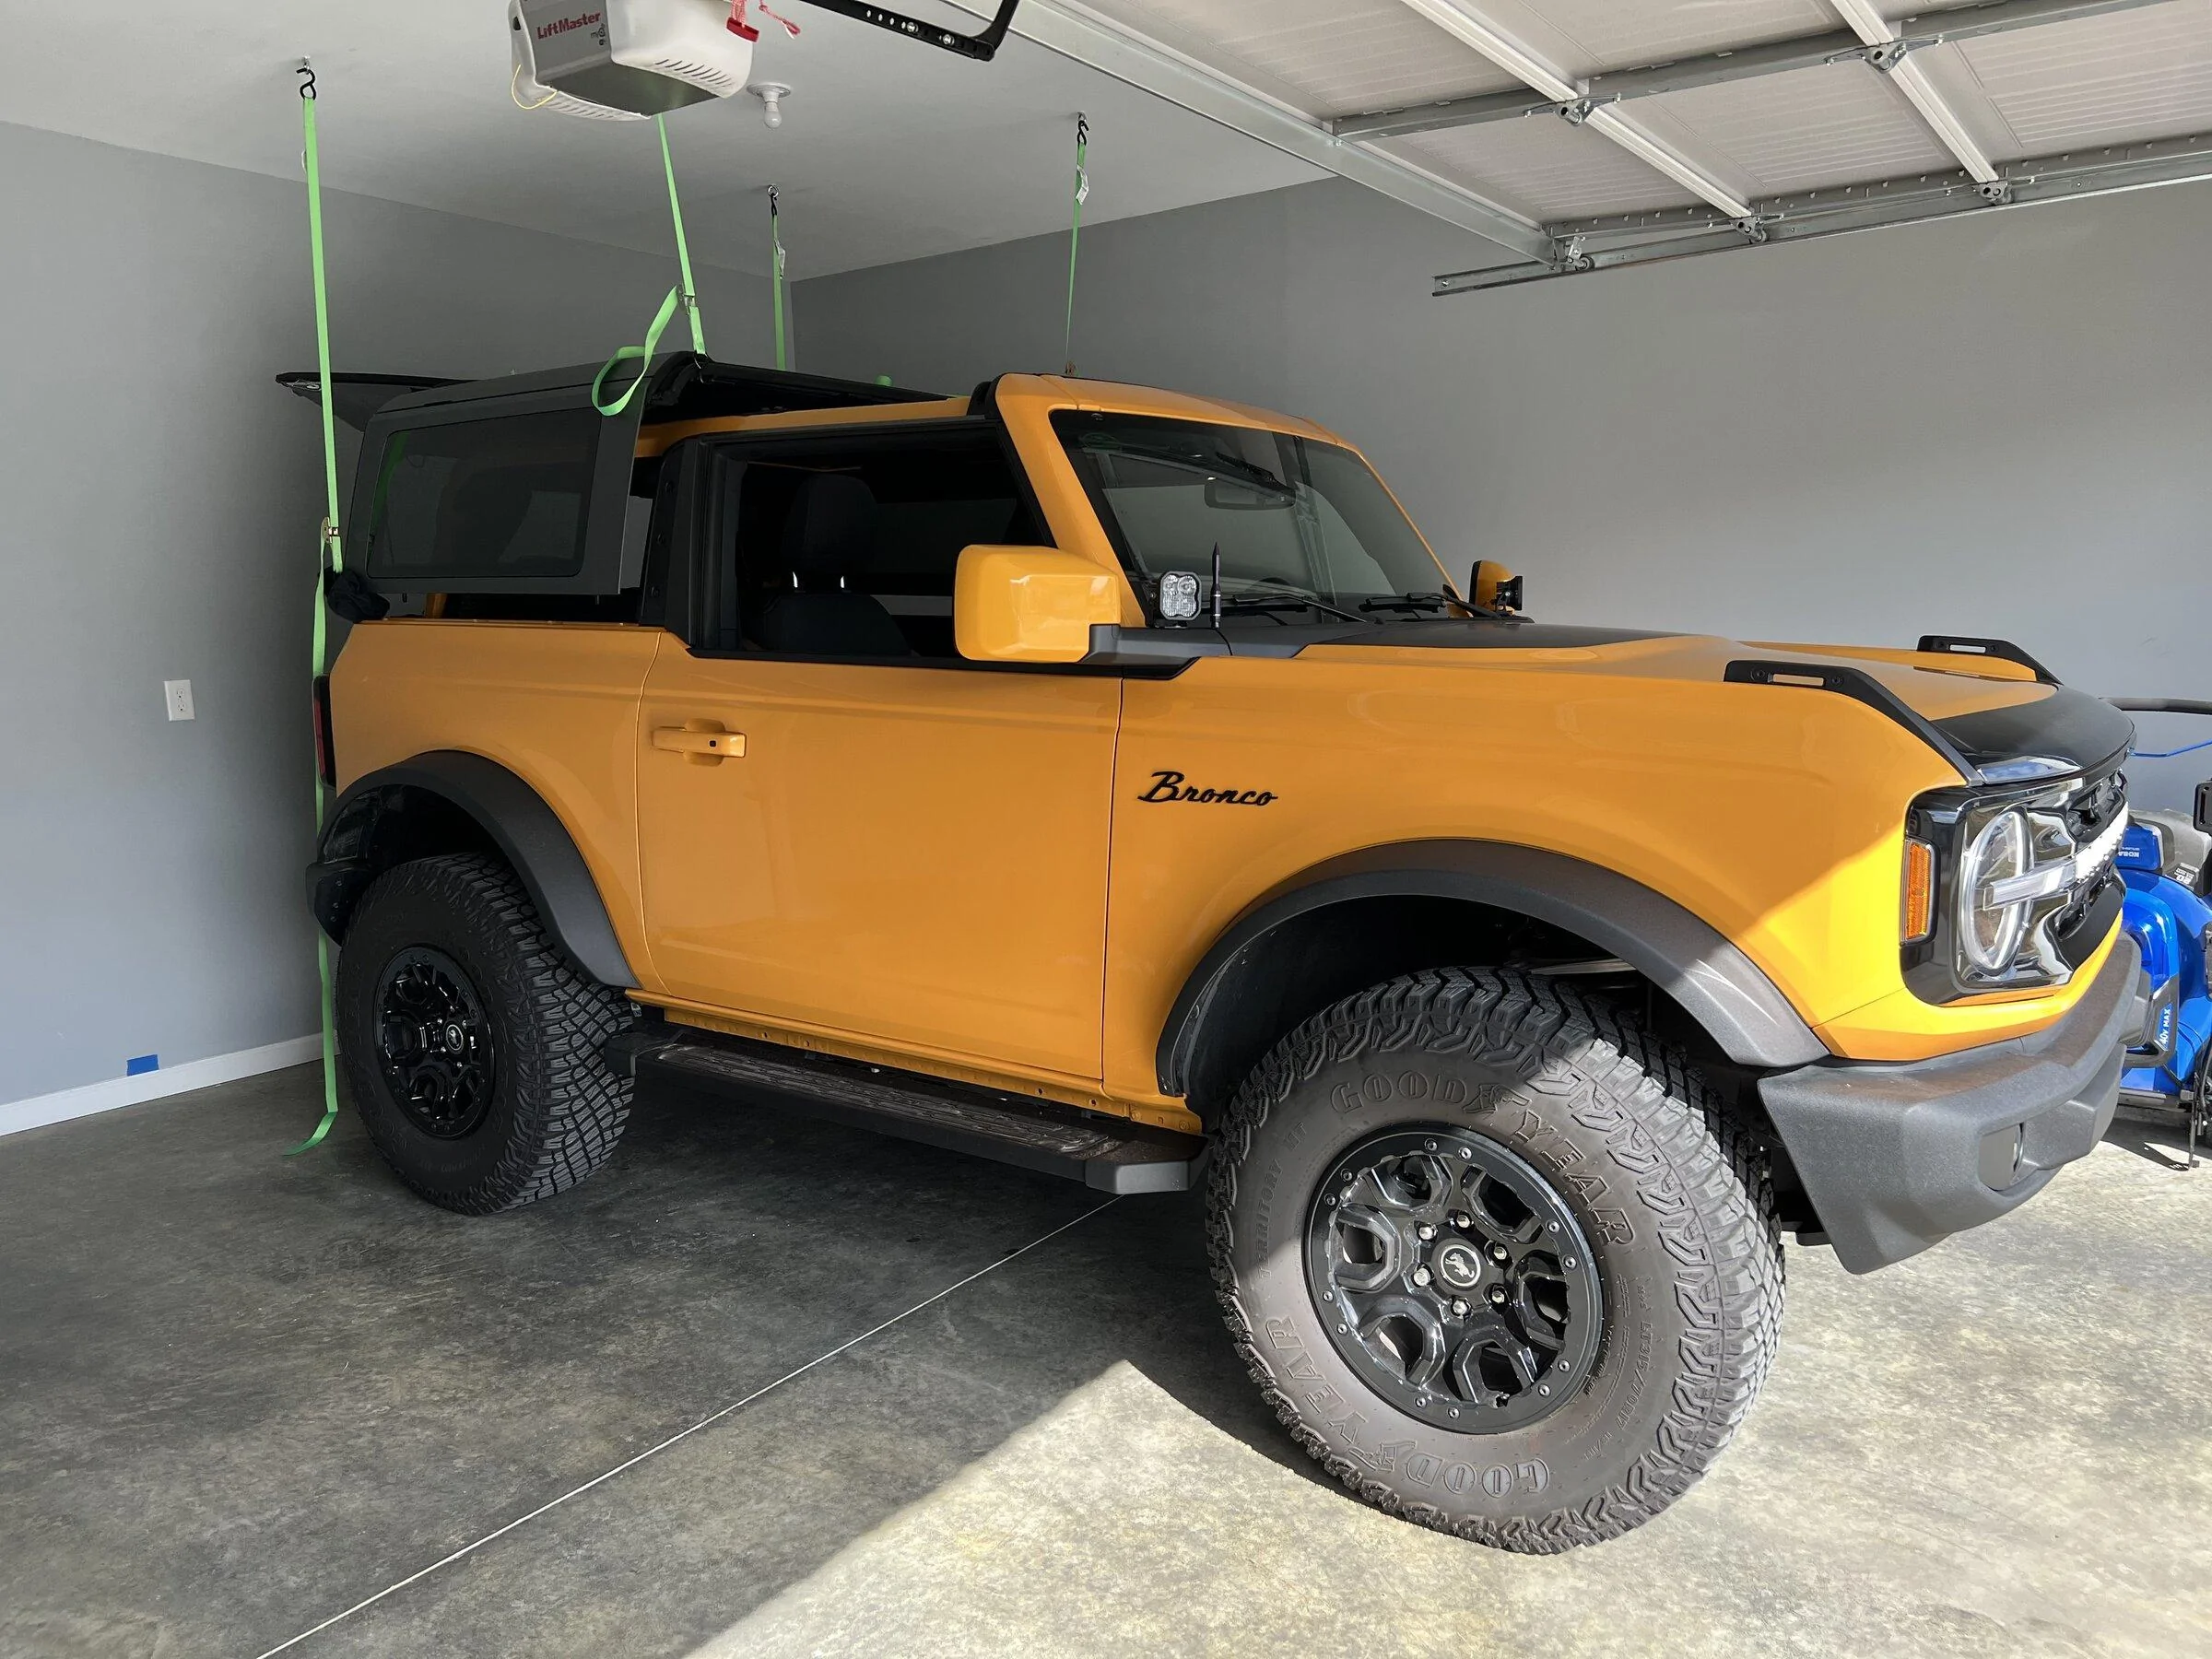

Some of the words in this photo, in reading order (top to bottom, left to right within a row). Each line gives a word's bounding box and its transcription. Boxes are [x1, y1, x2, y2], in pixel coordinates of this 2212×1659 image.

[536, 12, 601, 40] LiftMaster
[1137, 771, 1279, 806] Bronco
[1255, 1158, 1283, 1279] TERRITORY
[1615, 1320, 1653, 1430] LT315/70R17
